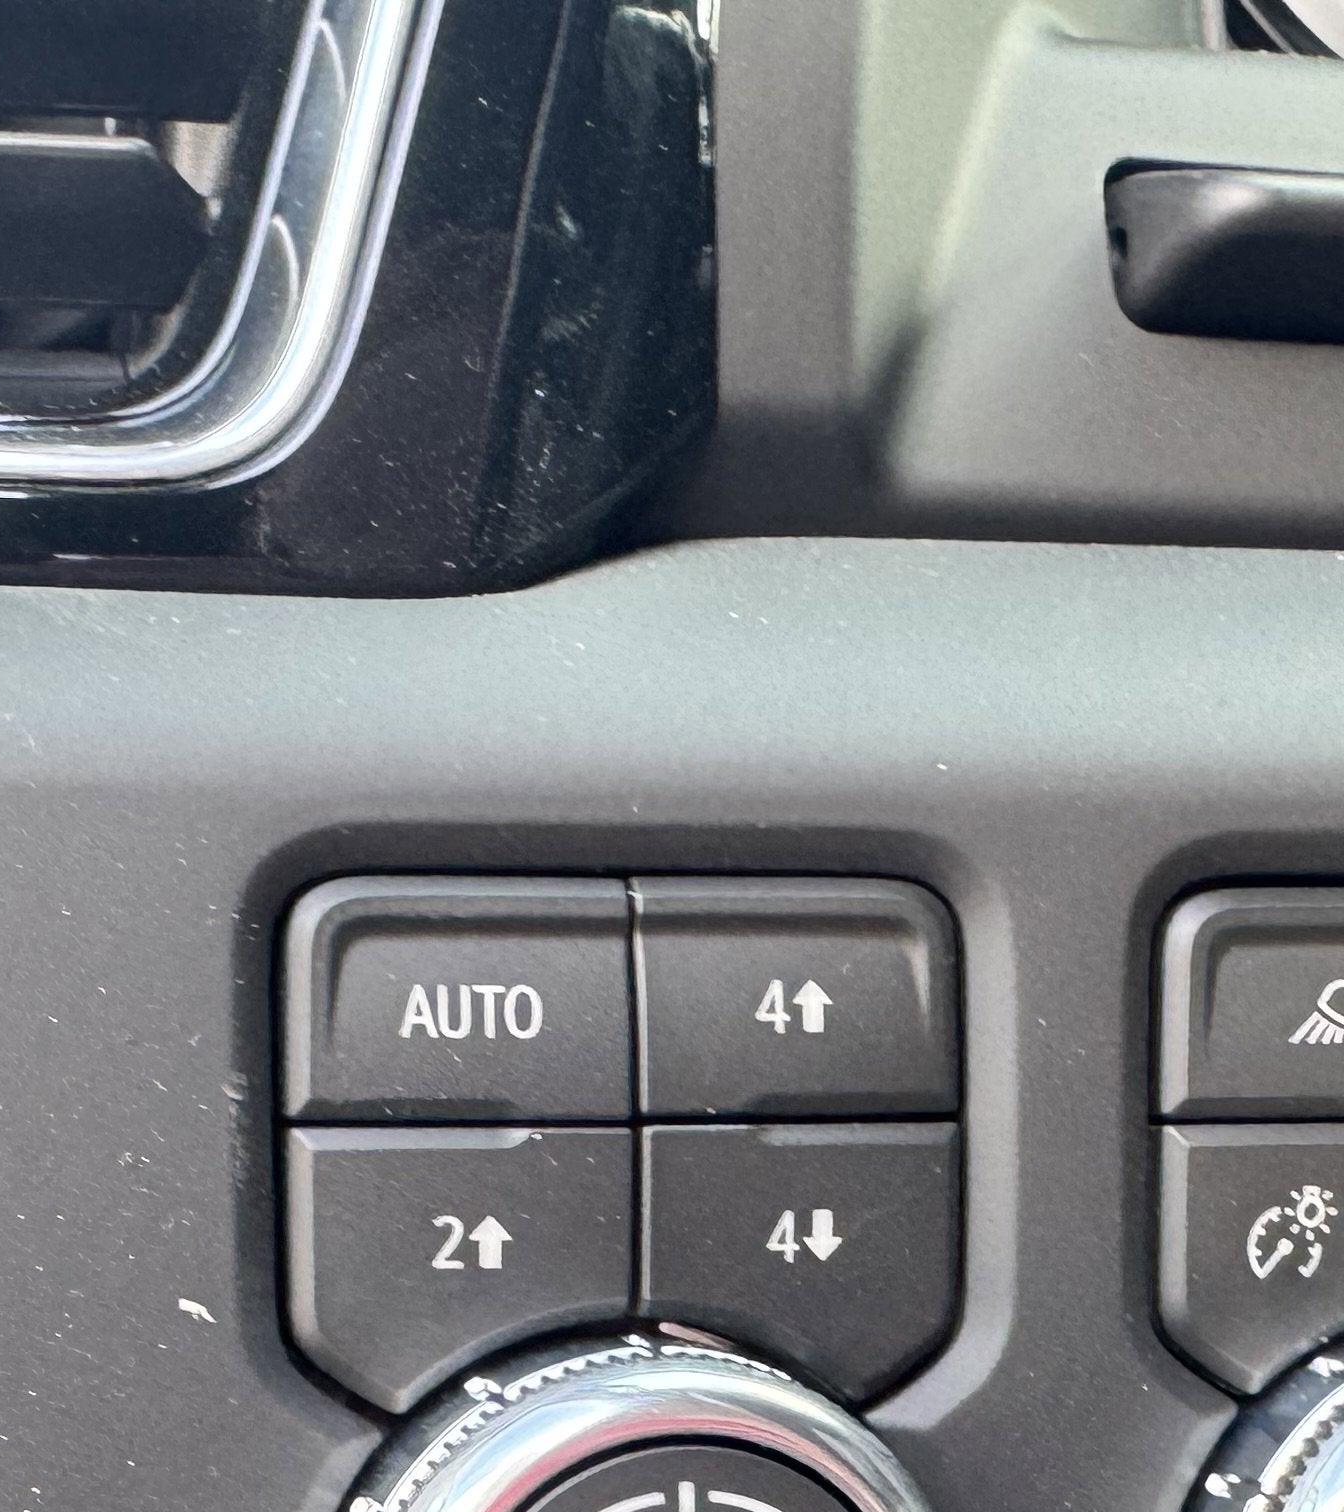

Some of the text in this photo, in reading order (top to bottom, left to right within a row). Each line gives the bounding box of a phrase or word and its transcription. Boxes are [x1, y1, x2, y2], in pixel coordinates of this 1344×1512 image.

[398, 983, 545, 1040] AUTO
[754, 979, 791, 1034] 4
[431, 1215, 465, 1270] 2
[765, 1209, 801, 1264] 4
